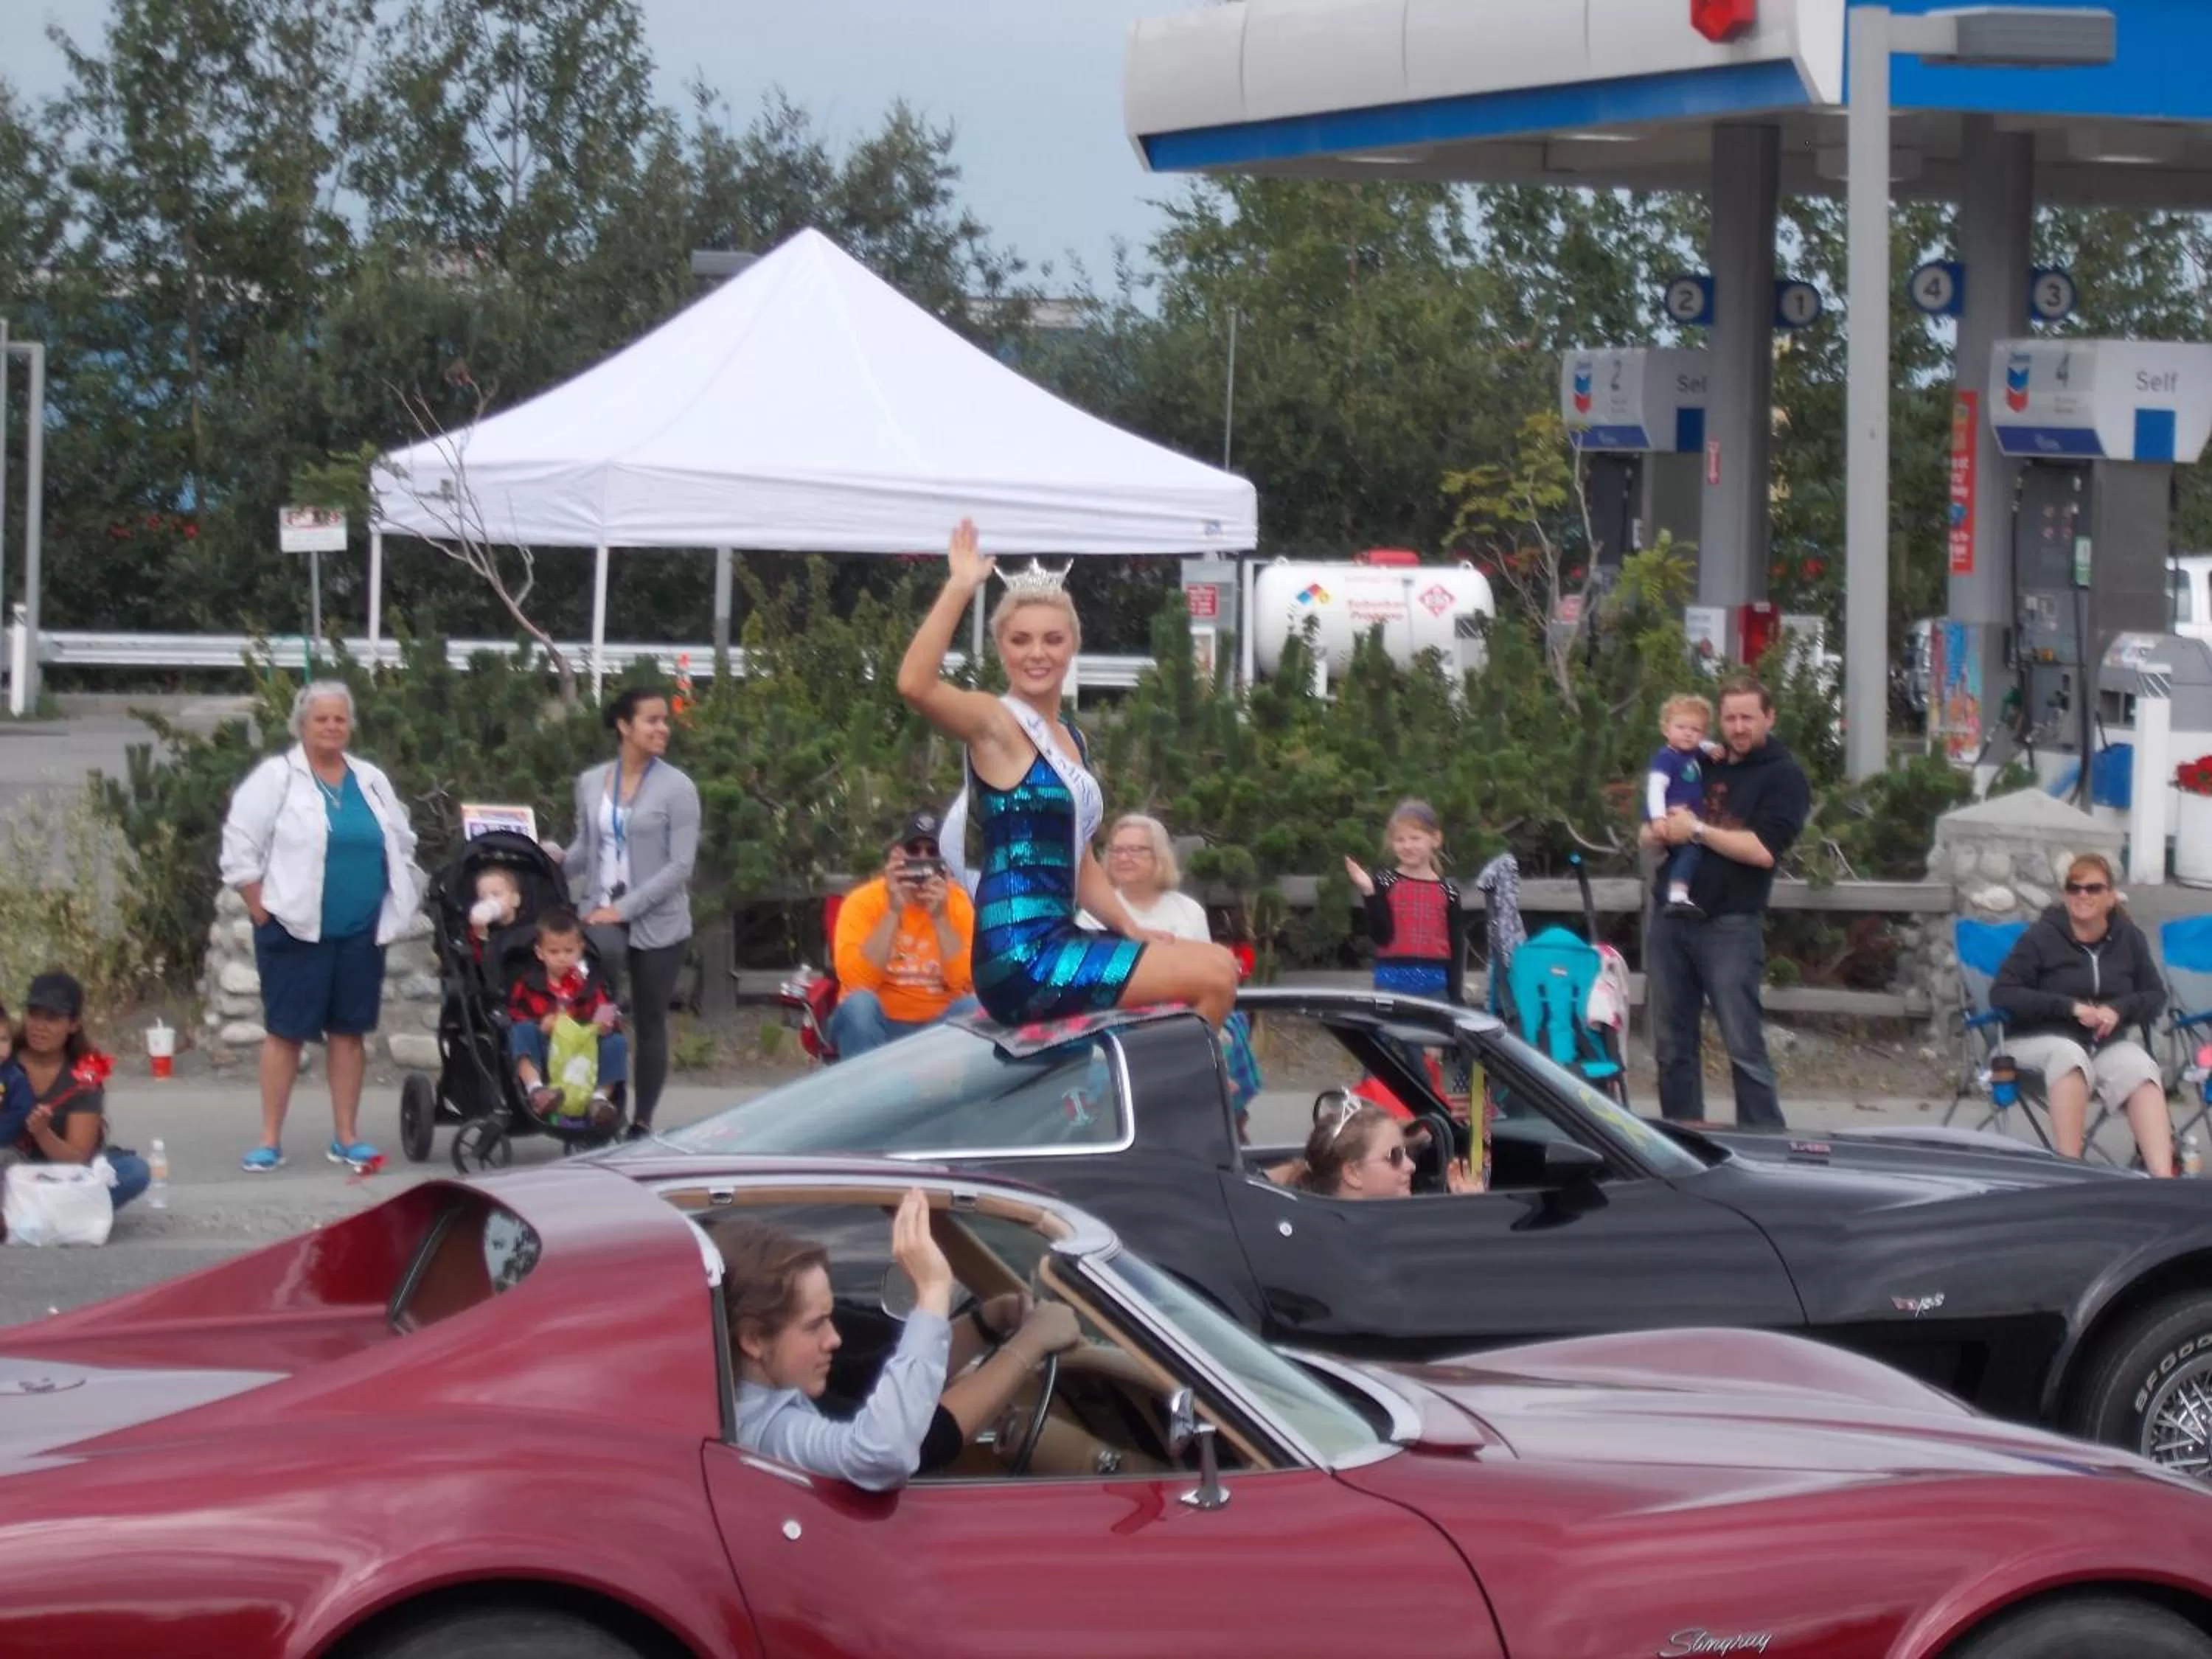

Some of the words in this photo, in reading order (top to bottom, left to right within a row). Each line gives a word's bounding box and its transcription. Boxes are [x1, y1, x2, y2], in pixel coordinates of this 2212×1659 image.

[1923, 276, 1941, 300] 4
[2046, 282, 2062, 307] 3
[1678, 290, 1694, 311] 2
[1795, 294, 1804, 316] 1
[1676, 374, 1708, 394] Sel
[2135, 369, 2178, 393] Self
[1658, 1627, 1773, 1658] Stingray
